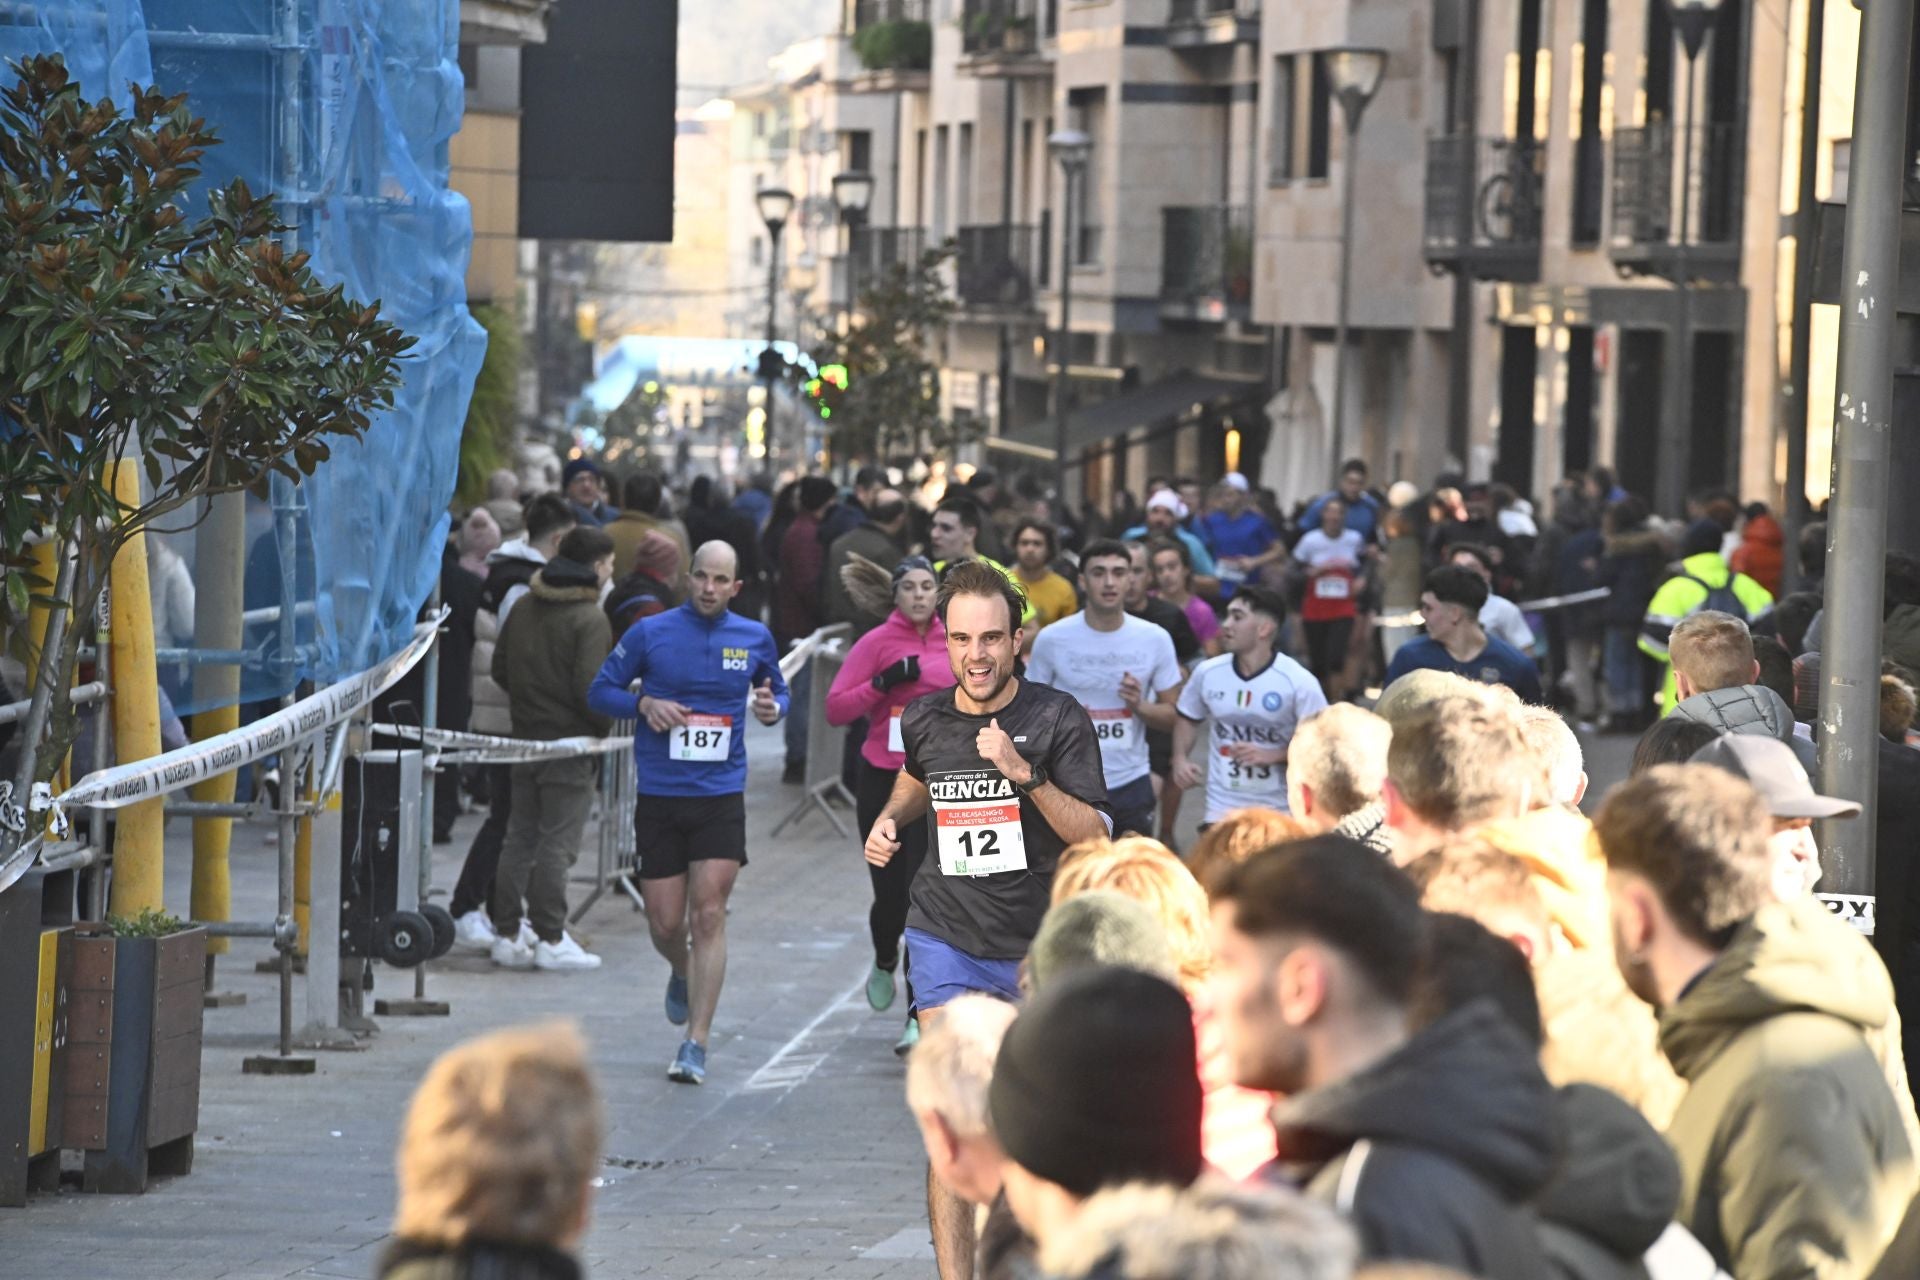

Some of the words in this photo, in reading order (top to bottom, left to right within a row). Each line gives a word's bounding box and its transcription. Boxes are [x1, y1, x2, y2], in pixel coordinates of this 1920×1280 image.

[723, 647, 749, 659] RUN
[723, 658, 748, 671] BOS
[679, 730, 723, 748] 187
[929, 778, 1014, 800] CIENCIA
[958, 829, 1001, 858] 12
